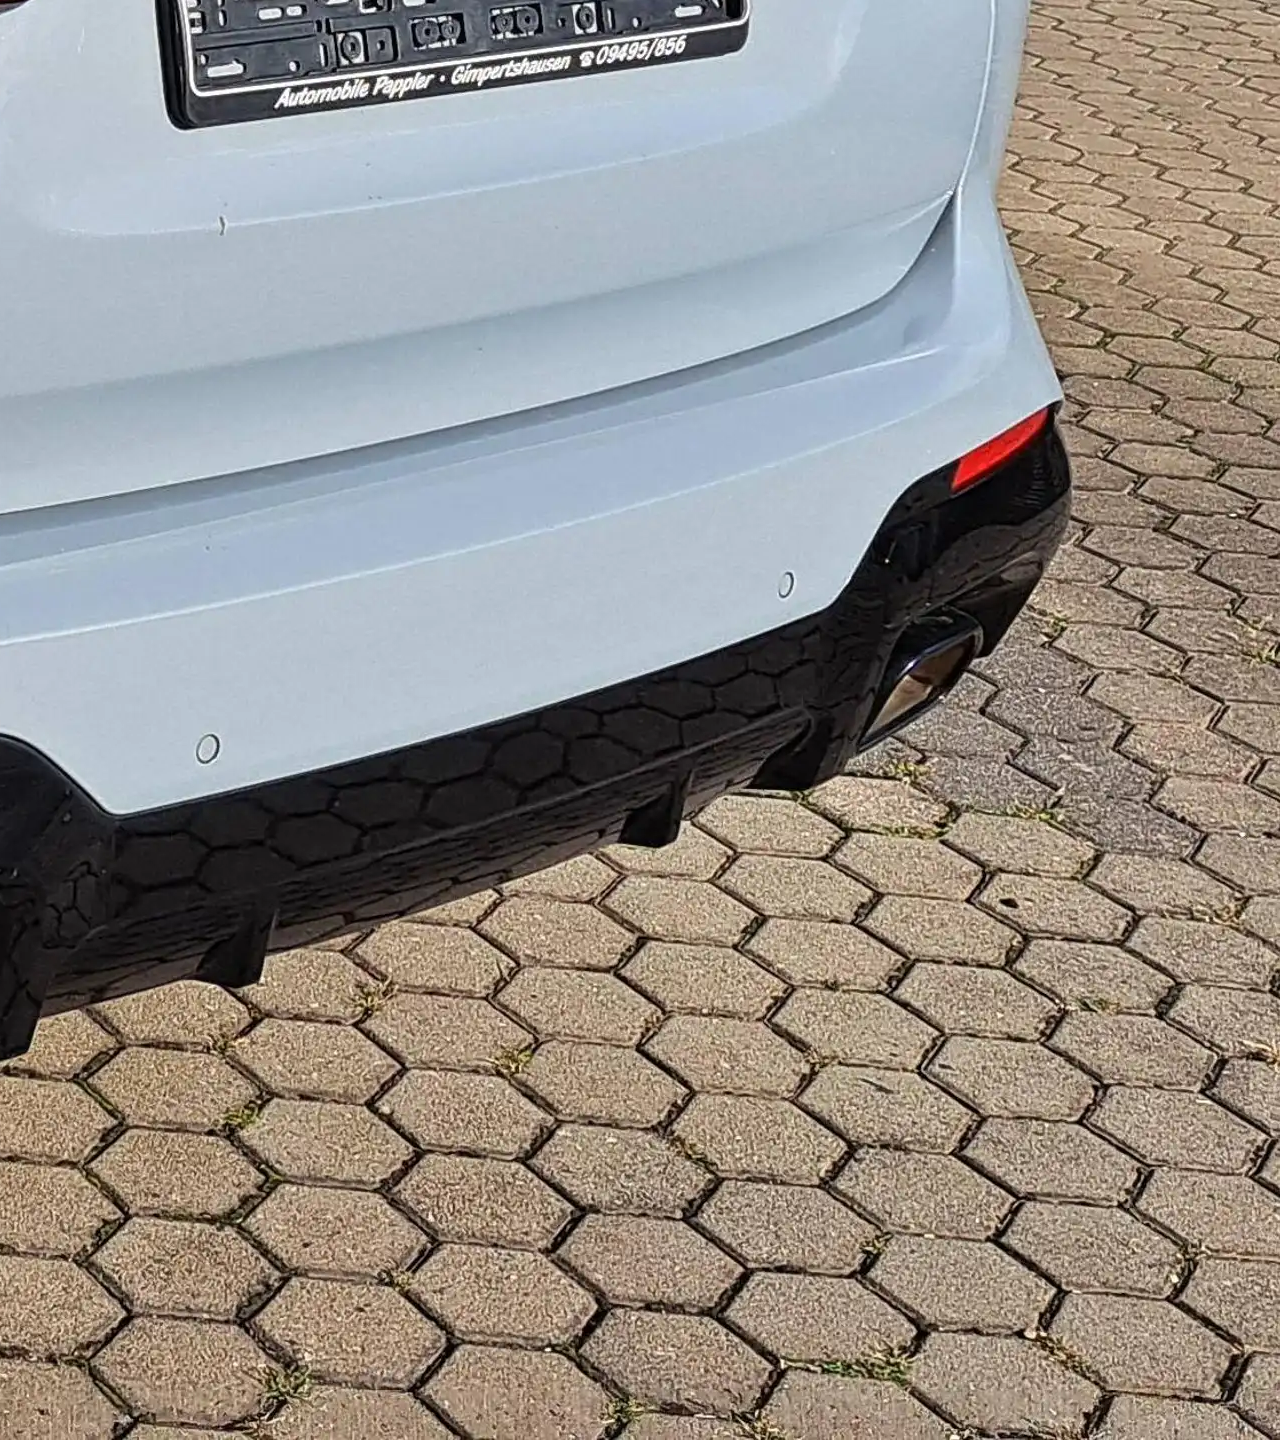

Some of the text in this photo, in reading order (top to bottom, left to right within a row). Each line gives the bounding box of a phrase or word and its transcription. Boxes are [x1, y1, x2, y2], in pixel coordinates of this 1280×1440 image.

[274, 34, 687, 109] Automobile Pappler Gimpertshausen 09495/856
